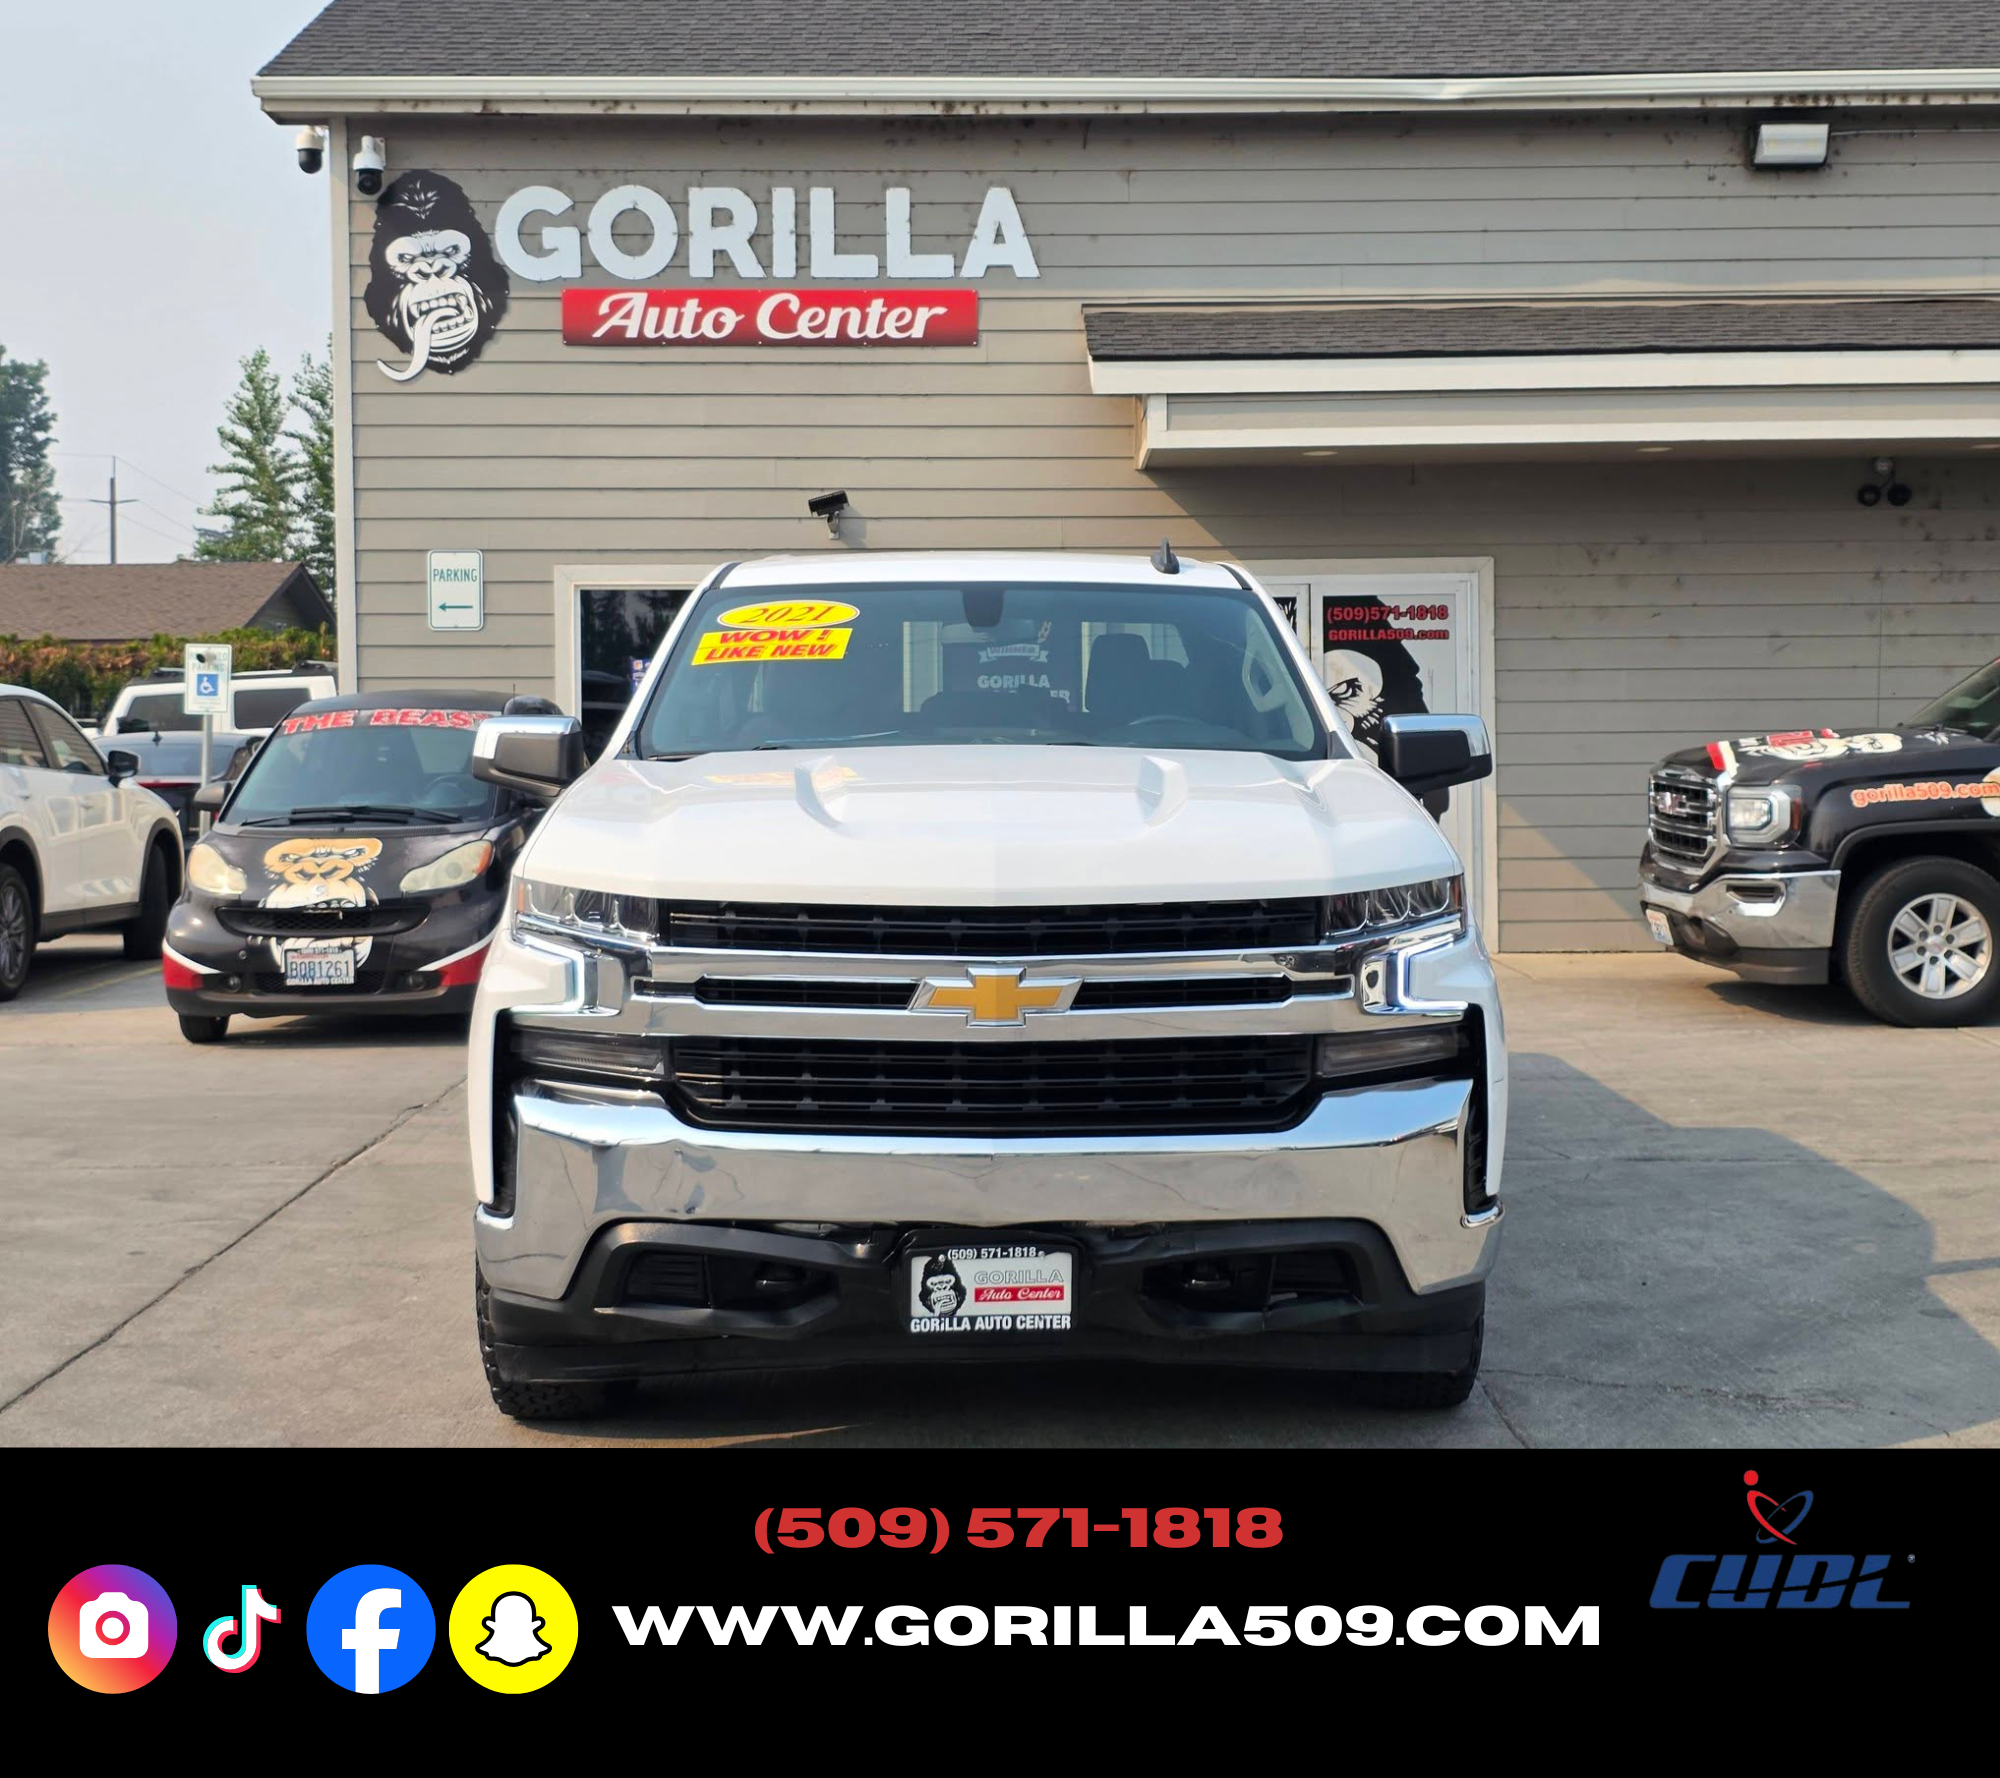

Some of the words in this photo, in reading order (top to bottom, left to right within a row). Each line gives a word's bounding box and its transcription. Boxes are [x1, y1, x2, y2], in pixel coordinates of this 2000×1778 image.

[496, 185, 1040, 280] GORILLA
[592, 291, 744, 340] Auto
[756, 291, 947, 340] Center
[433, 568, 478, 582] PARKING
[740, 605, 836, 623] 2021
[1326, 604, 1449, 624] (509)571-1818
[1328, 628, 1449, 641] GORILLA509.com
[704, 644, 767, 662] LIKE
[769, 643, 837, 657] NEW
[282, 710, 358, 735] THE
[1851, 781, 2000, 808] gorilla509.com
[947, 1249, 977, 1260] (509)
[981, 1247, 1036, 1259] 571-1818
[974, 1269, 1064, 1285] GORILLA
[978, 1287, 1013, 1301] Auto
[1016, 1287, 1062, 1300] Center
[910, 1317, 971, 1333] GORILLA
[975, 1315, 1012, 1331] AUTO
[1016, 1314, 1071, 1330] CENTER
